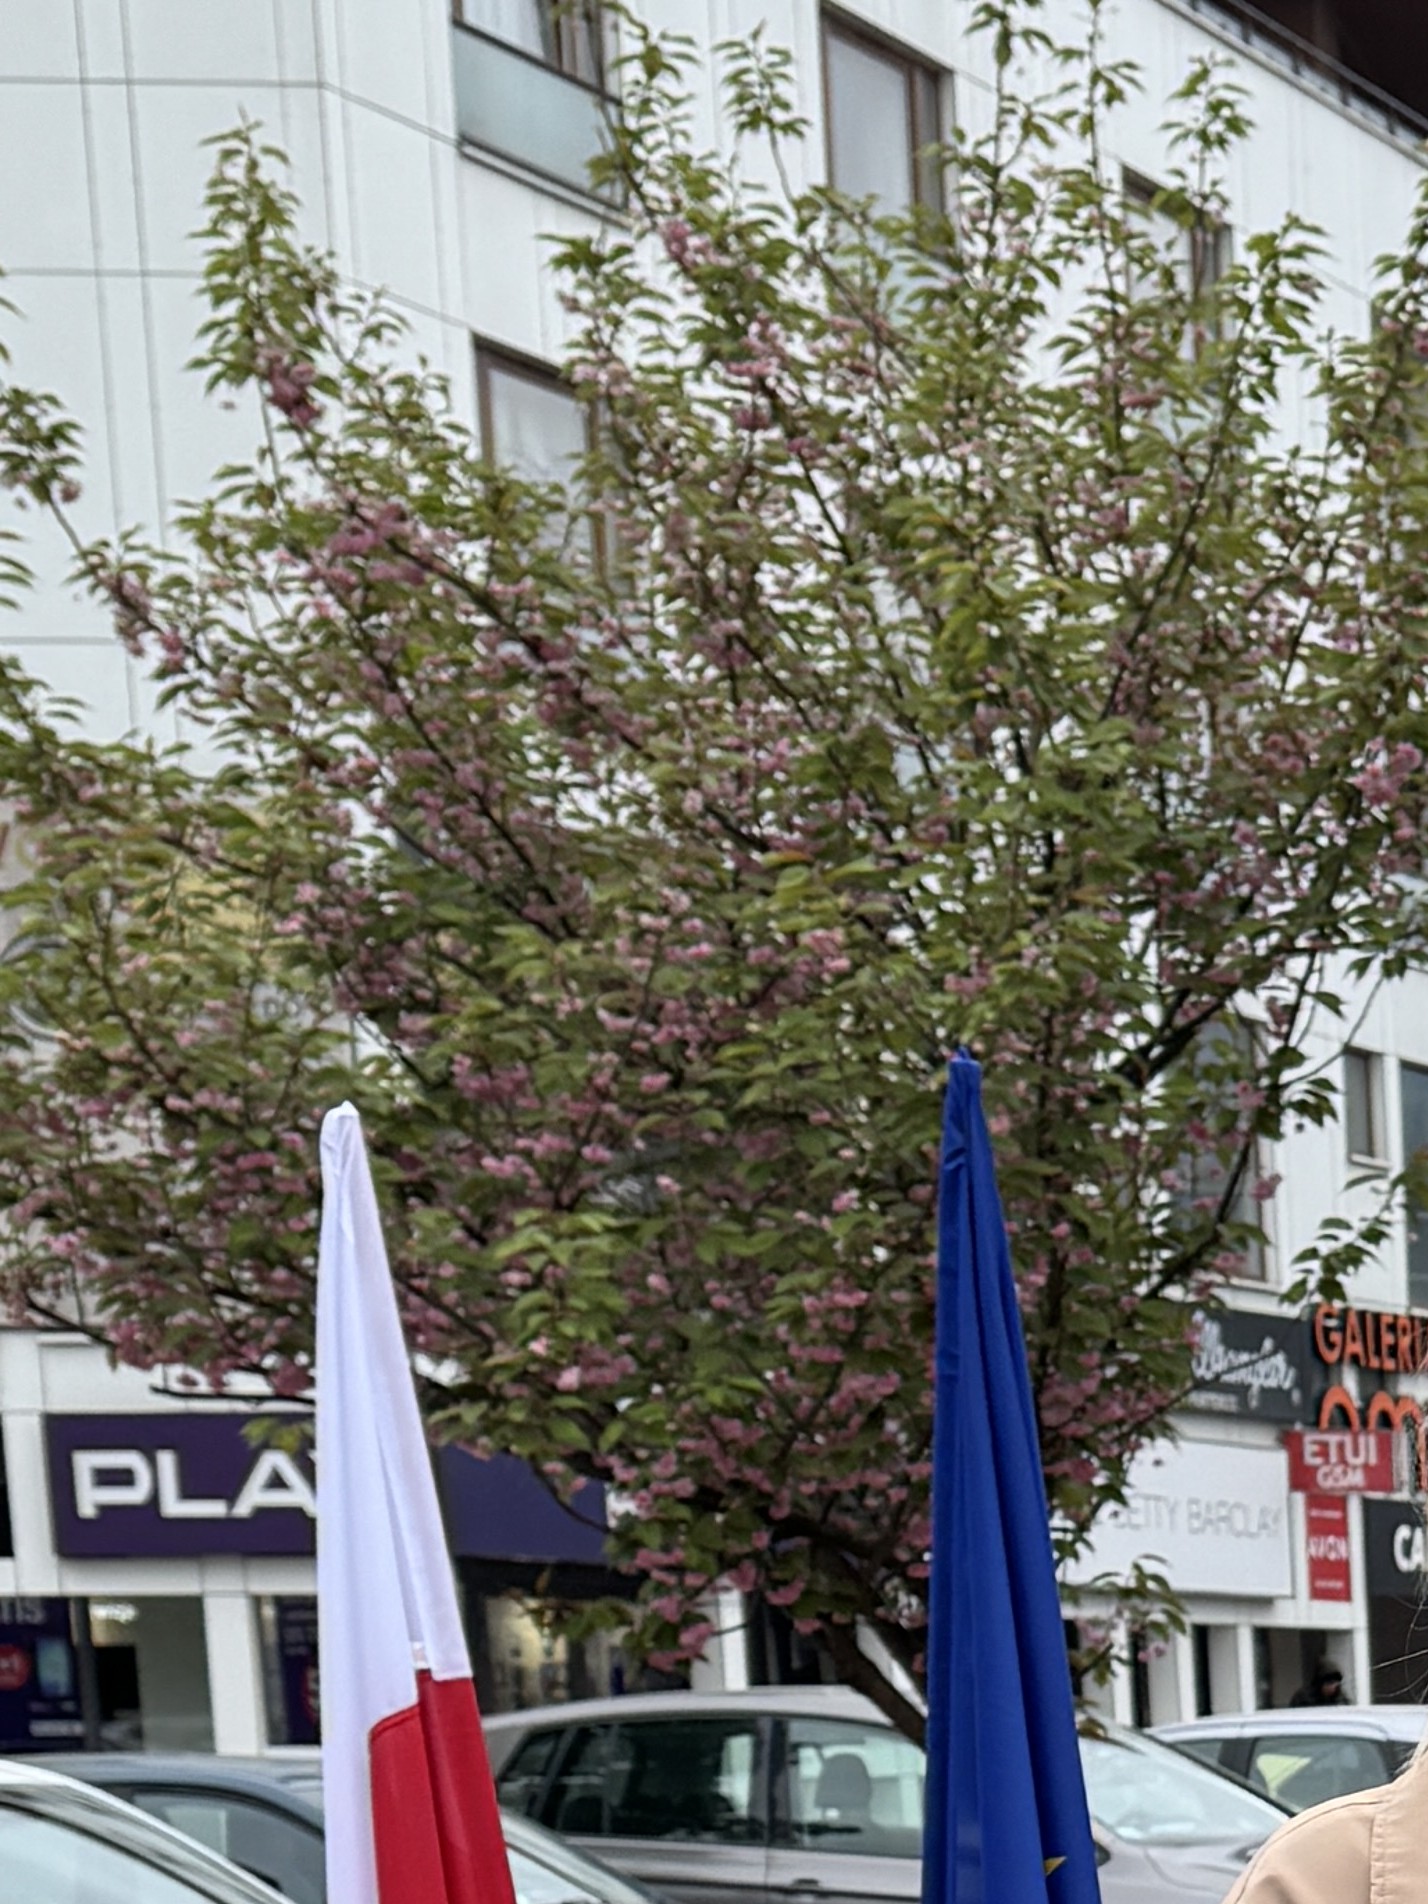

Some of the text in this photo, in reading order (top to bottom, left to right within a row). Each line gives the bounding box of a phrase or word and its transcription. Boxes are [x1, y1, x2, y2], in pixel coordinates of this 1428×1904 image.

[1303, 1433, 1379, 1467] ETUI
[71, 1449, 316, 1519] PLA
[1393, 1524, 1428, 1573] CA
